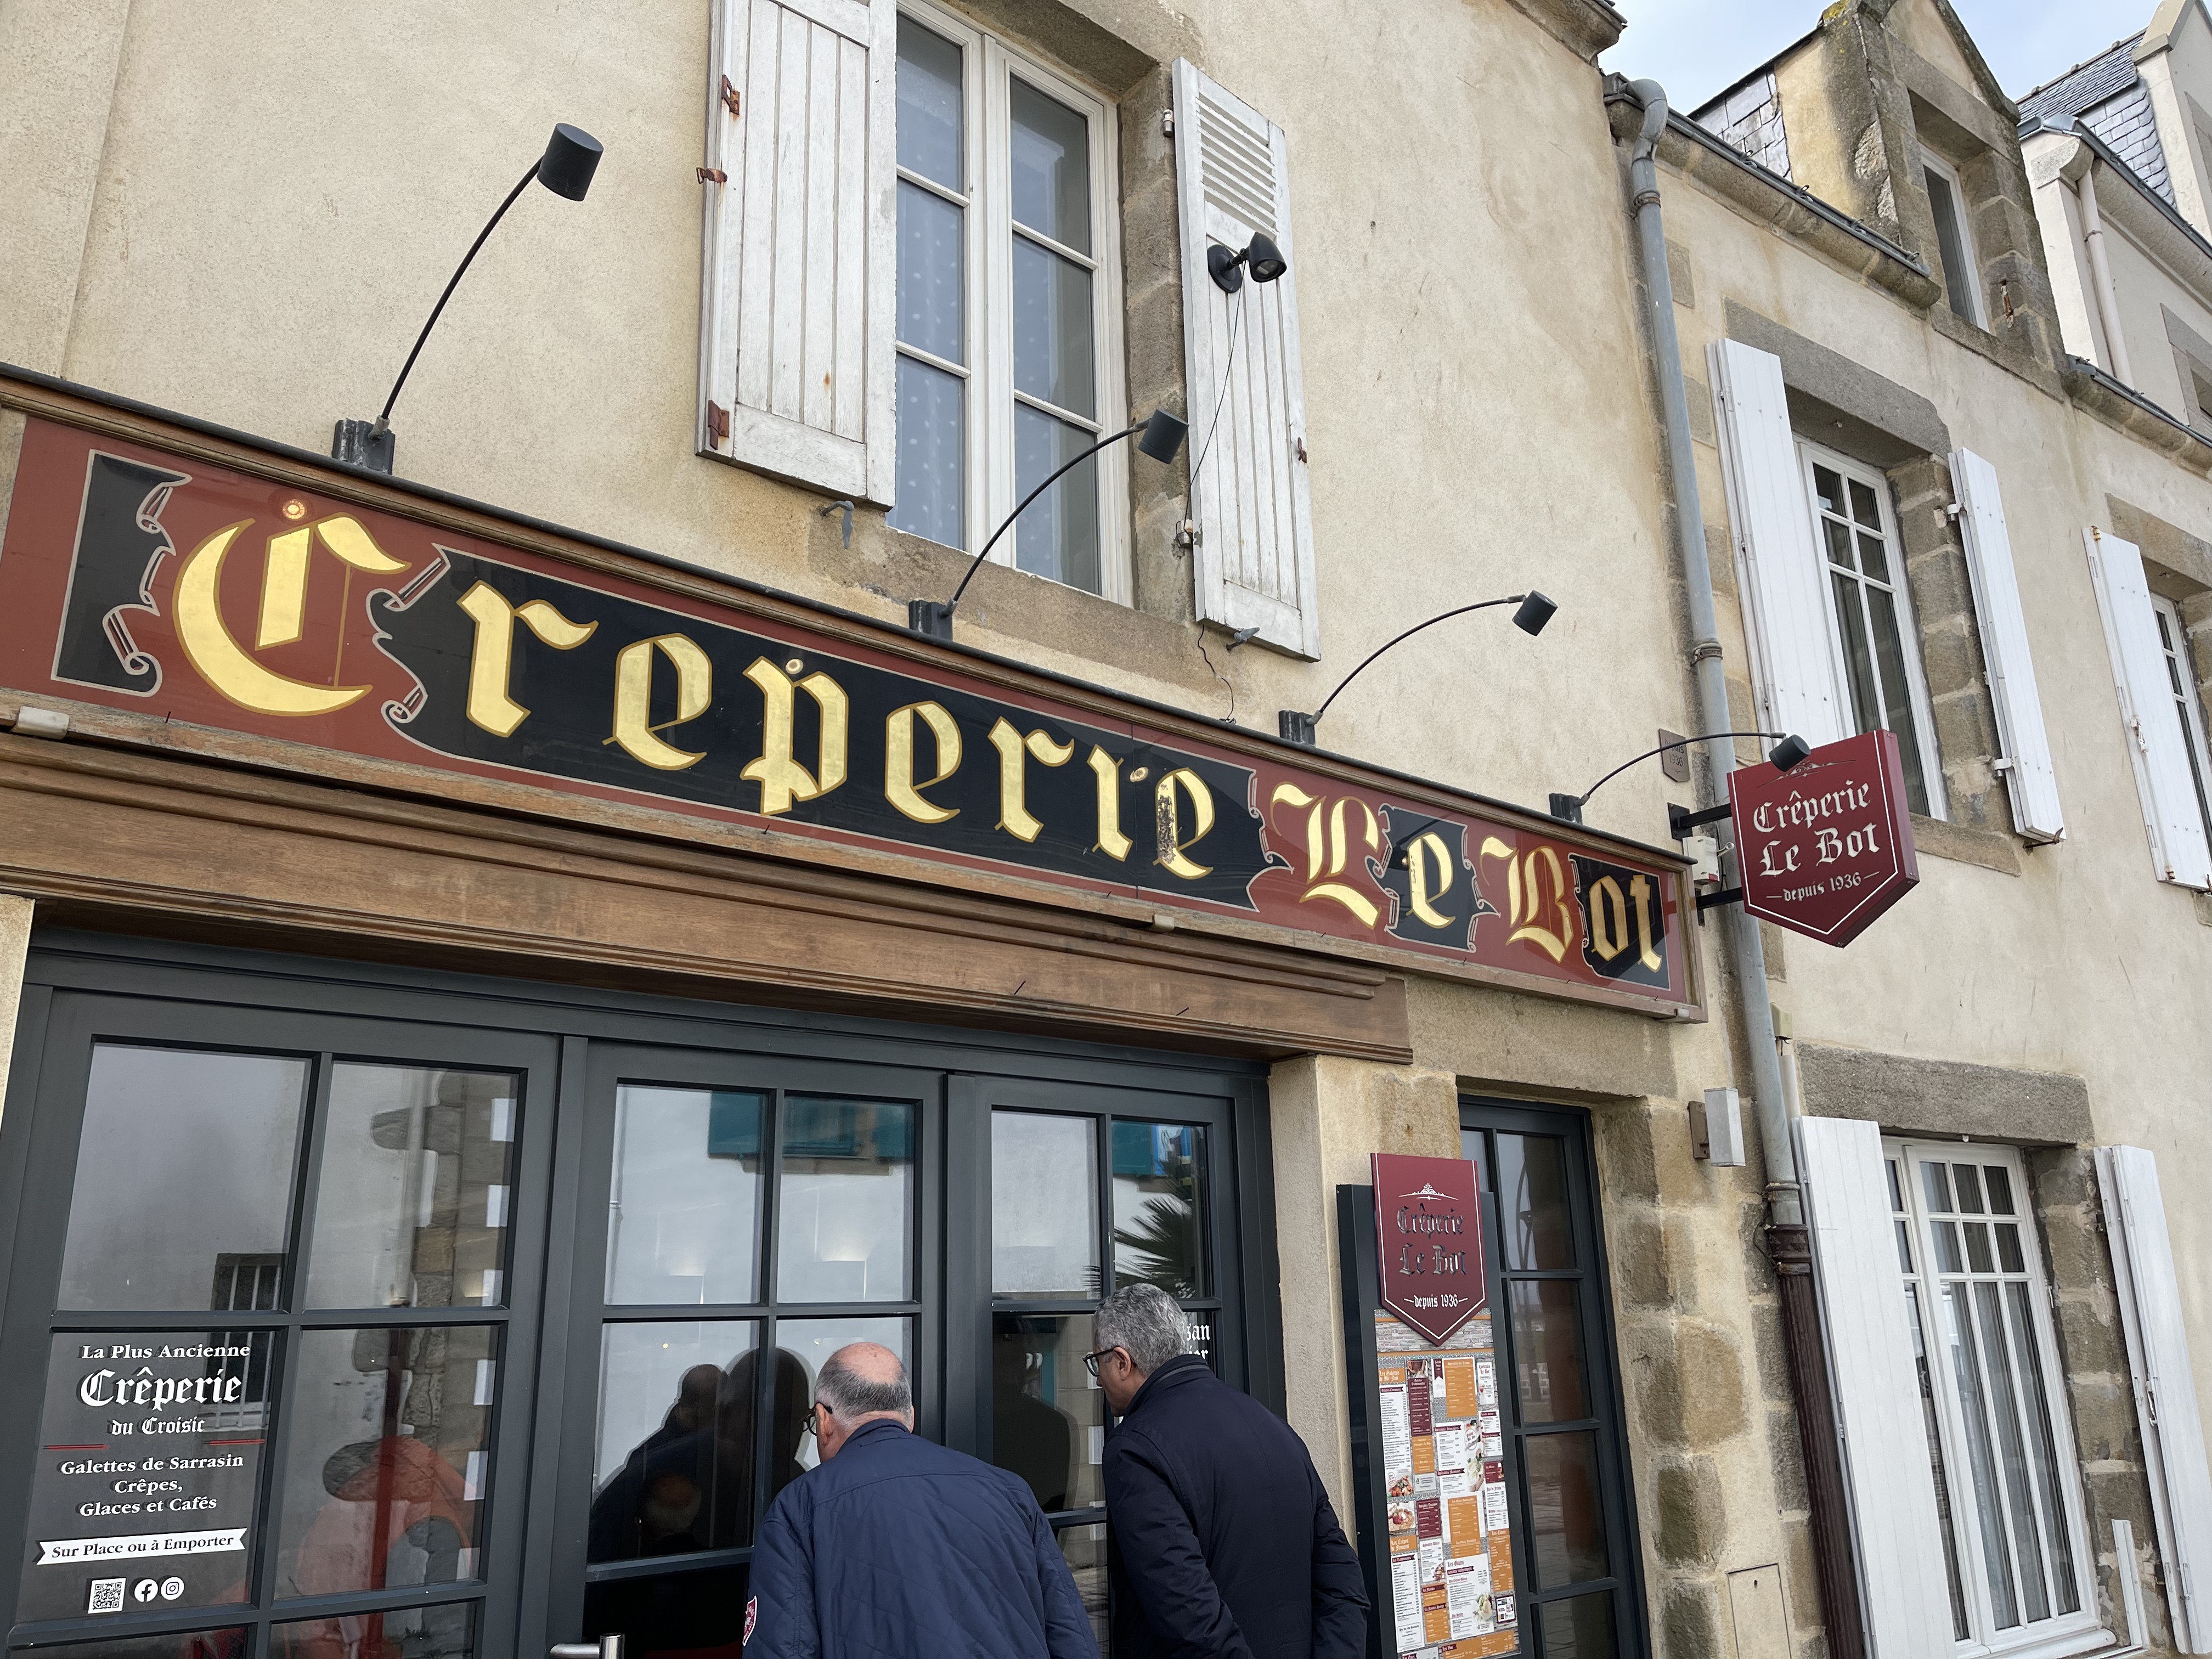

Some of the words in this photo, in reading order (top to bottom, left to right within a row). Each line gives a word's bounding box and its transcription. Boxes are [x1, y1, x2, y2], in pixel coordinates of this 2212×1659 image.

[172, 511, 1216, 881] Creperie
[1269, 781, 1457, 930] Le
[1479, 834, 1663, 974] Bot
[1668, 752, 1684, 767] 1936
[1753, 779, 1871, 833] Crêperie
[1759, 839, 1802, 878] Le
[1813, 822, 1881, 867] Bot
[1782, 879, 1825, 902] depuis
[1830, 871, 1862, 892] 1936
[1396, 1202, 1465, 1240] Crêperie
[1398, 1242, 1426, 1277] Le
[1432, 1244, 1468, 1276] Bot
[1413, 1293, 1438, 1310] depuis
[1441, 1294, 1459, 1308] 1936
[81, 1345, 105, 1359] La
[111, 1345, 153, 1359] Plus
[157, 1344, 251, 1359] Ancienne
[80, 1366, 242, 1412] Crêperie
[111, 1419, 133, 1436] du
[142, 1417, 206, 1436] Croisic
[61, 1459, 136, 1475] Galettes
[142, 1457, 164, 1471] de
[169, 1454, 244, 1470] Sarrasin
[114, 1479, 183, 1496] Crêpes,
[80, 1502, 140, 1517] Glaces
[146, 1499, 164, 1513] et
[169, 1496, 217, 1512] Cafés
[52, 1545, 80, 1559] Sur
[83, 1542, 123, 1557] Place
[127, 1542, 146, 1553] ou
[151, 1539, 160, 1551] à
[163, 1536, 234, 1553] Emporter
